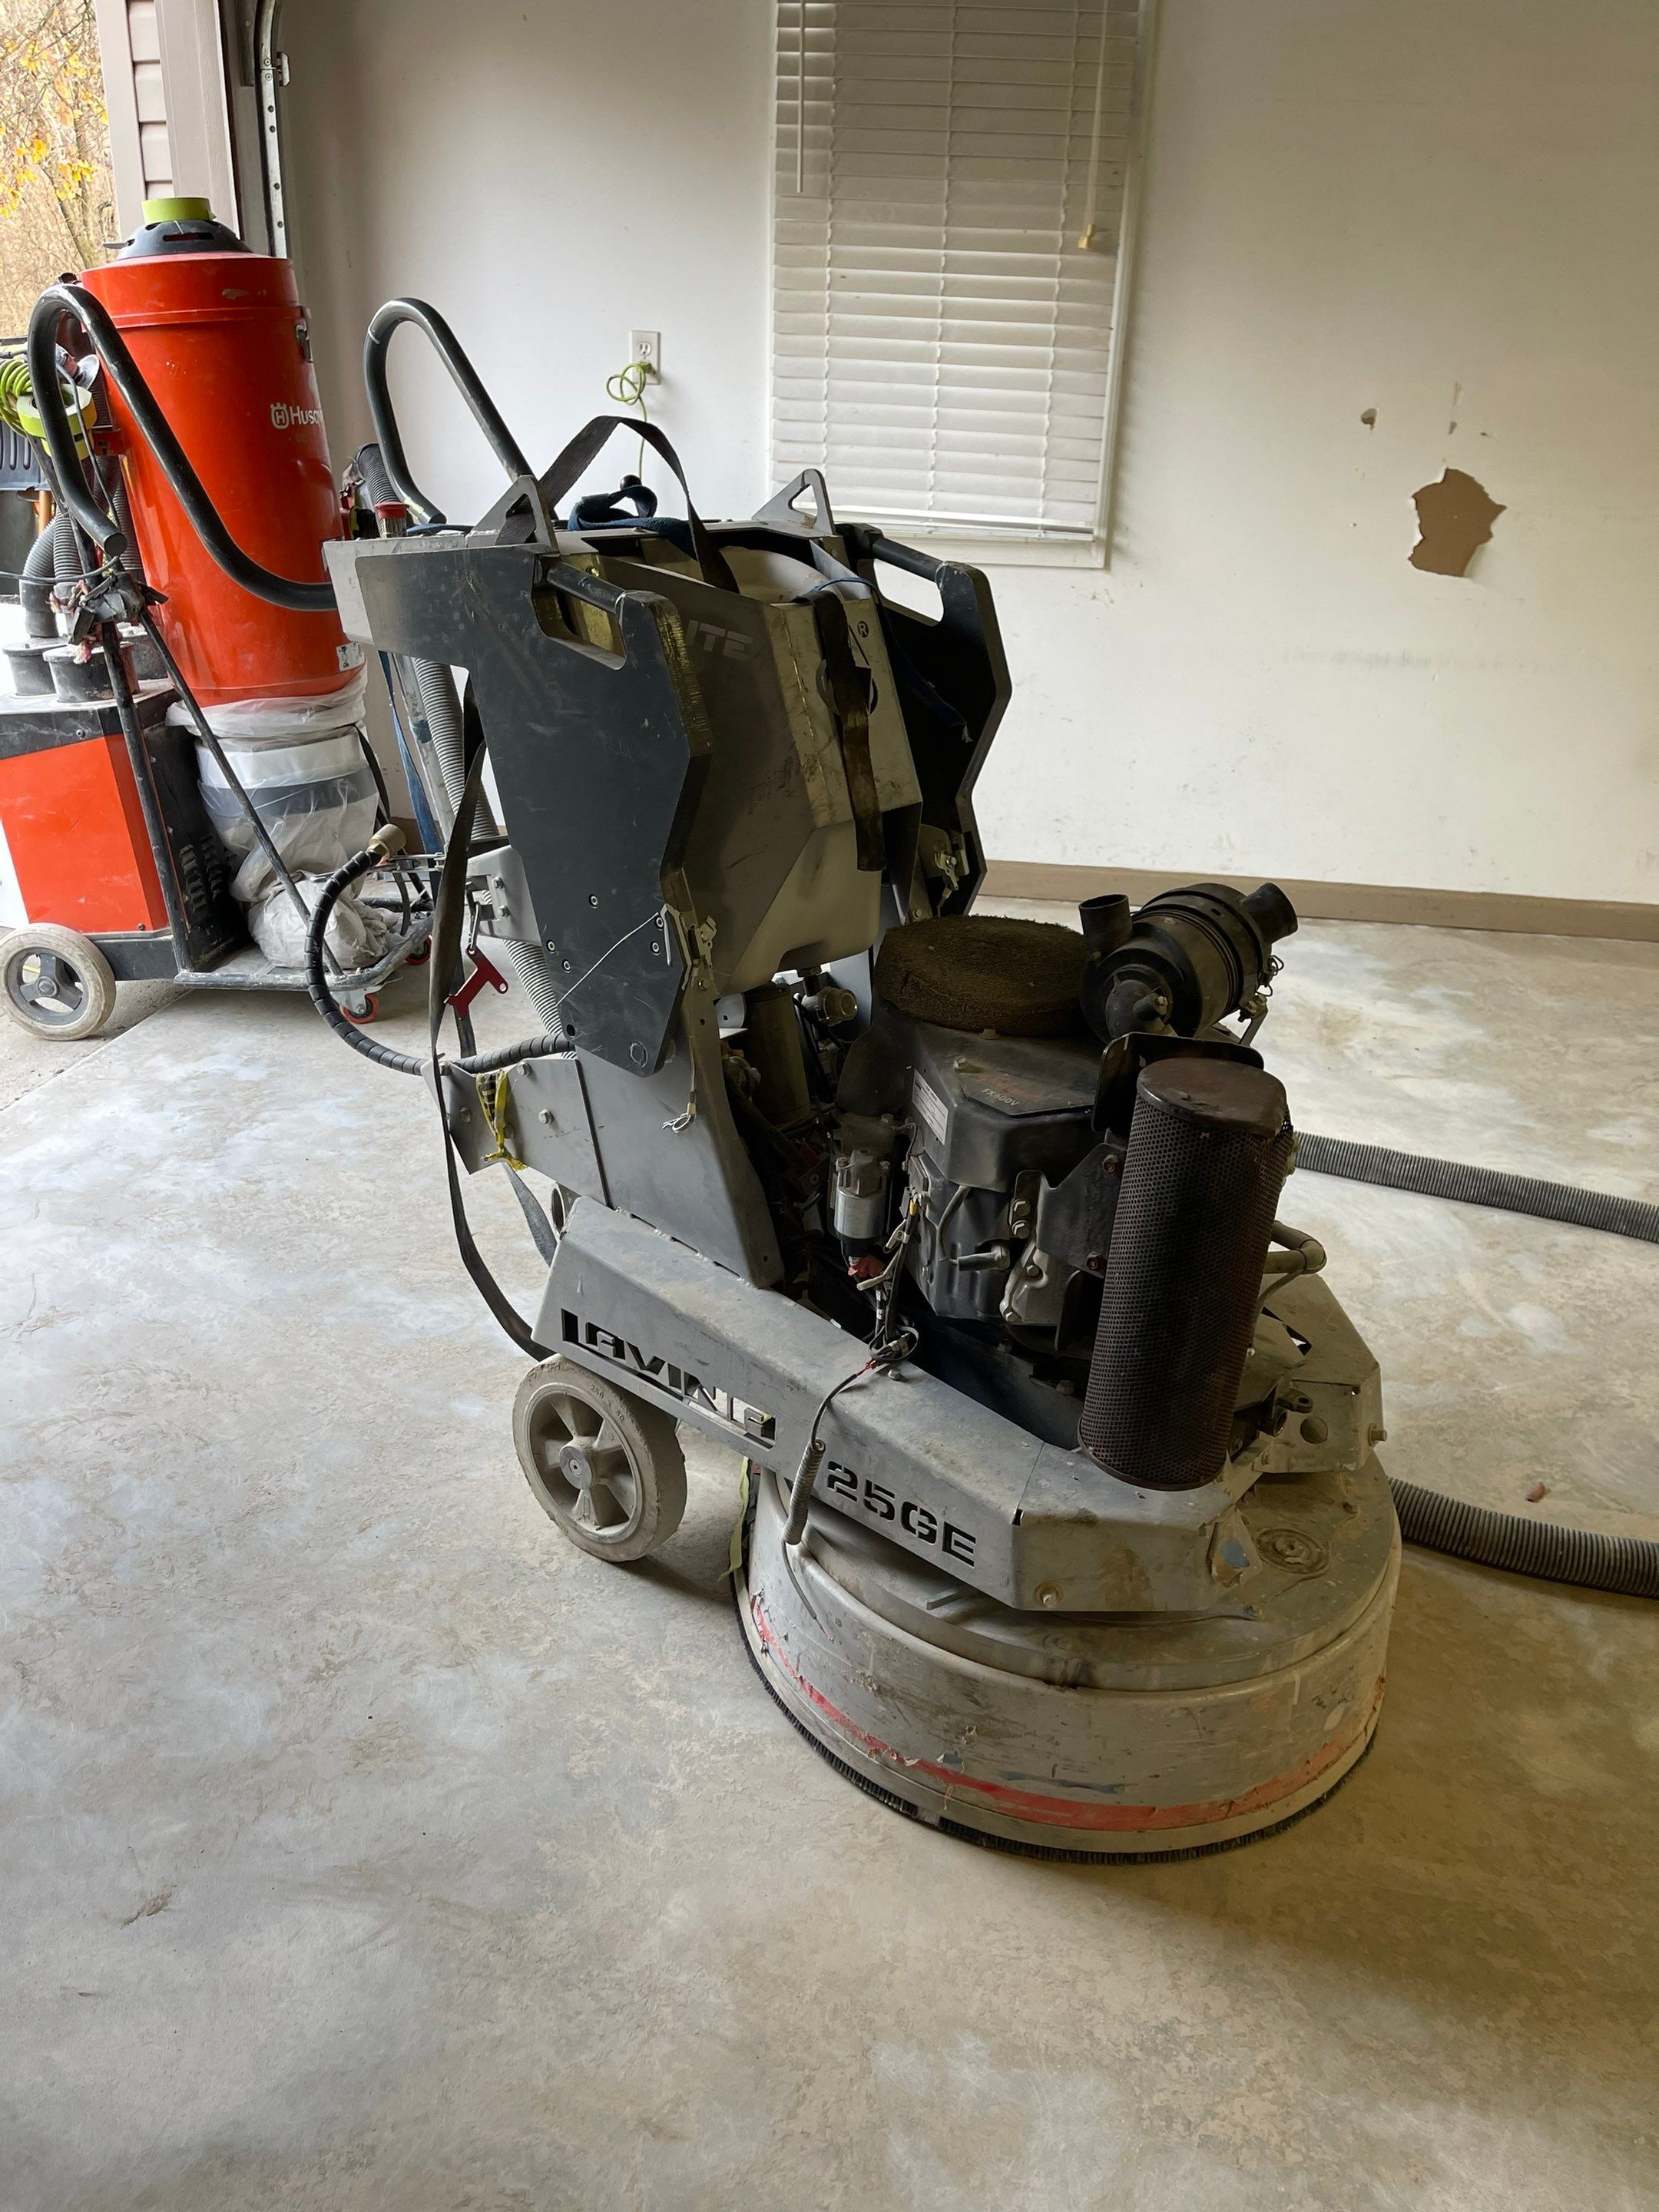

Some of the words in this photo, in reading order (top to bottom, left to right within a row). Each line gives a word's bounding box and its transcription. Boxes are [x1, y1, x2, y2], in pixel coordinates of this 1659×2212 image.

[290, 406, 323, 427] Husq
[687, 620, 753, 661] ITE
[827, 1461, 976, 1568] 25GE
